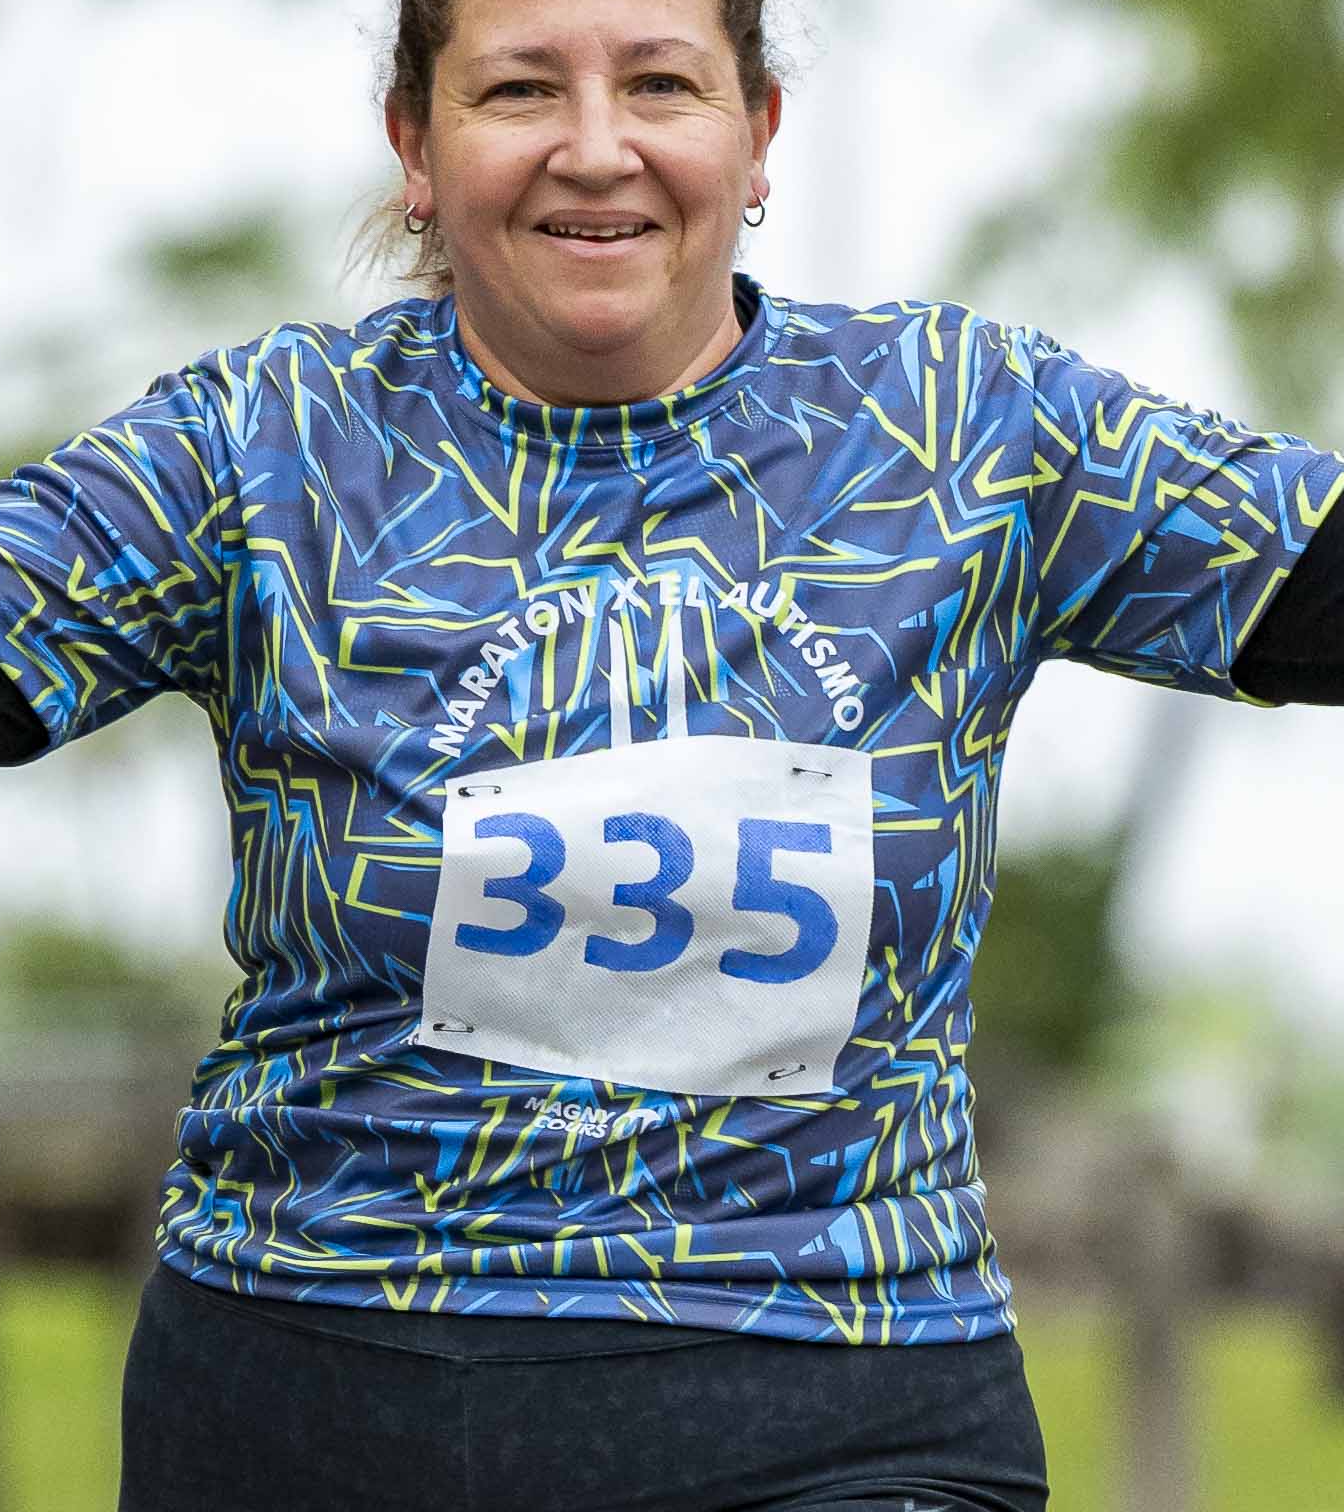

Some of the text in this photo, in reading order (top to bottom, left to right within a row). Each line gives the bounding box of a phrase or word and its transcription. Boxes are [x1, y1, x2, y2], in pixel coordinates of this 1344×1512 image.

[608, 577, 644, 611] X
[659, 573, 707, 609] EL
[718, 580, 864, 731] AUTISMO
[455, 812, 839, 985] 335
[524, 1096, 617, 1124] MAGNY
[534, 1114, 609, 1139] COURS
